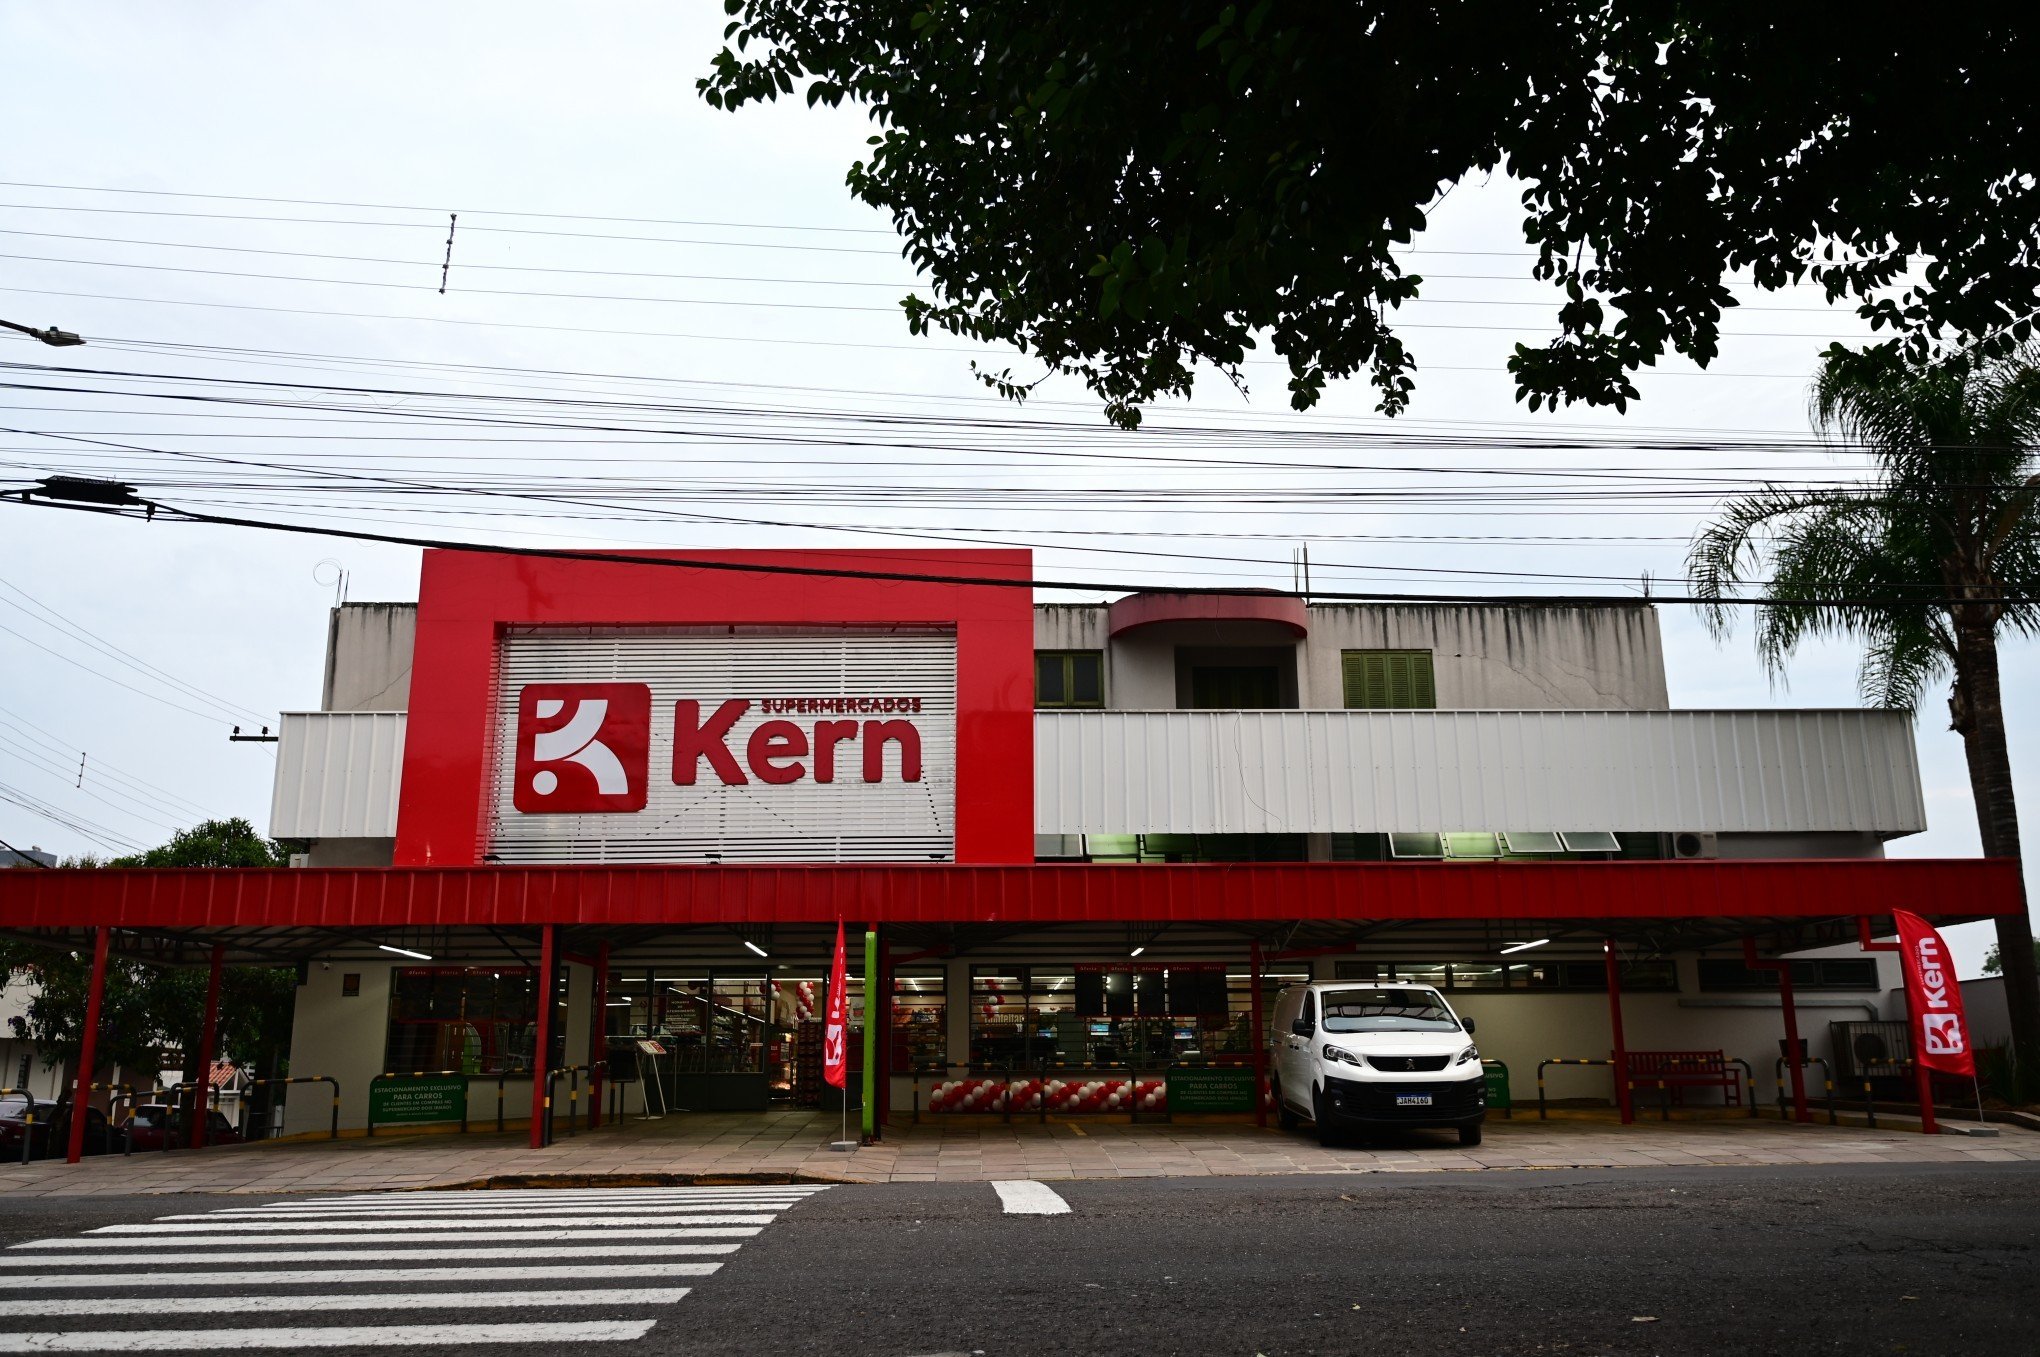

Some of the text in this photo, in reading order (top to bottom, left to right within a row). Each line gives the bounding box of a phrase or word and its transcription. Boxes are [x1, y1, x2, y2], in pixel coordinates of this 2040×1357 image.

[761, 698, 922, 713] SUPERMERCADOS
[671, 699, 921, 786] Kern
[1918, 937, 1949, 1008] Kern
[374, 1085, 428, 1093] ESTACIONAMENTO
